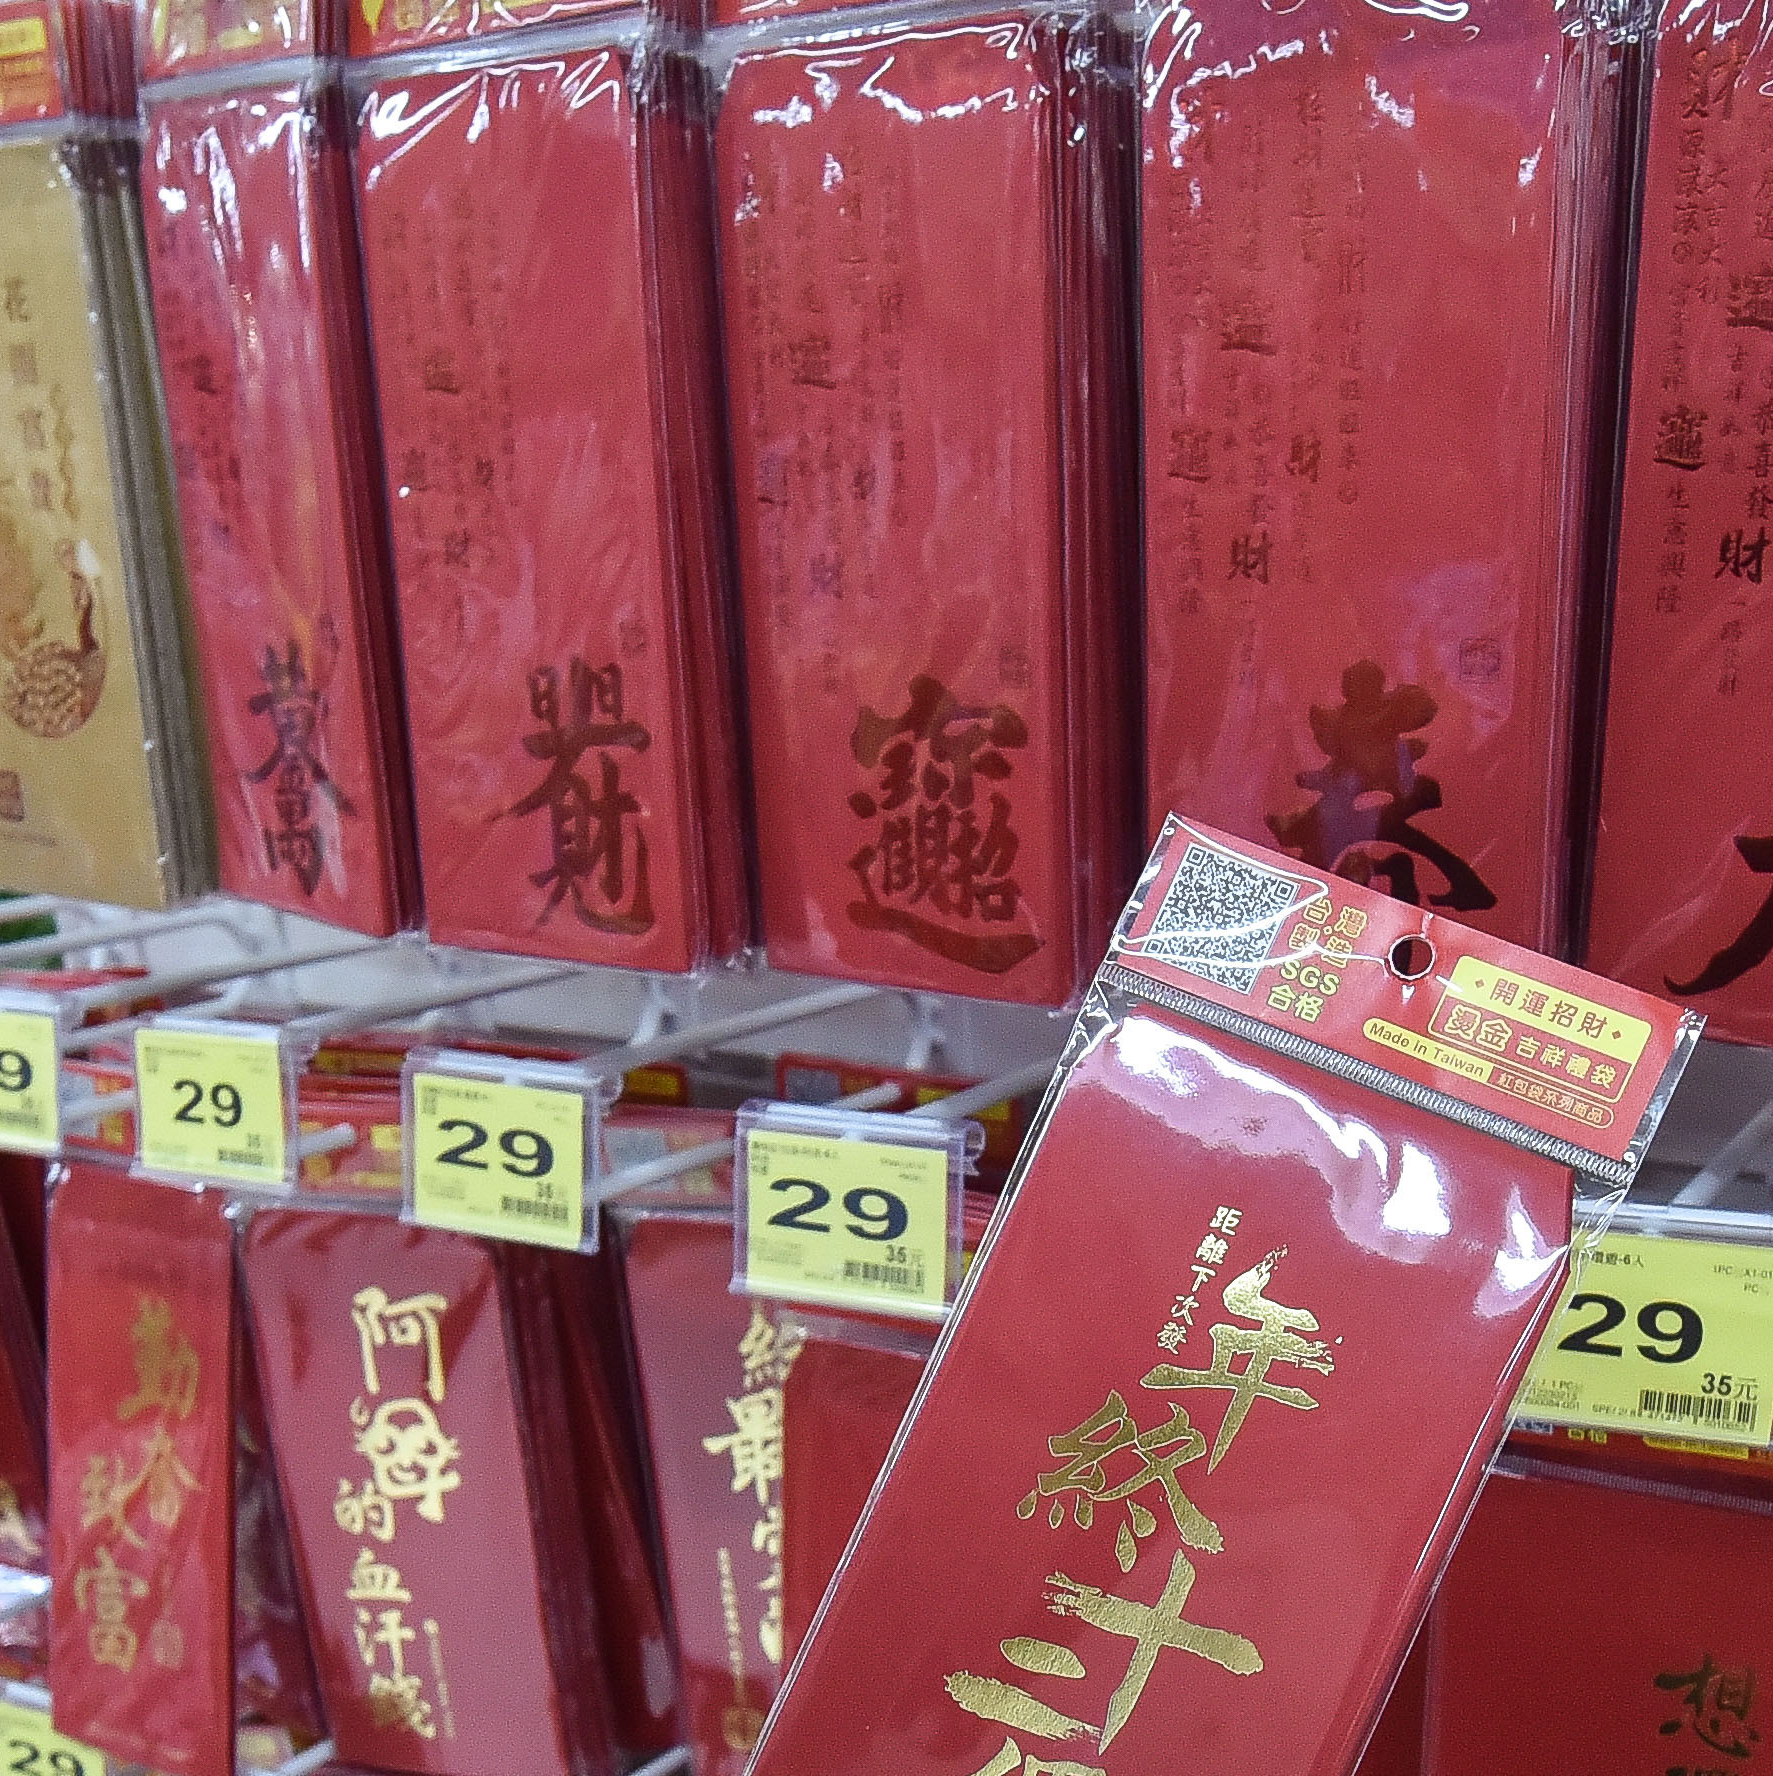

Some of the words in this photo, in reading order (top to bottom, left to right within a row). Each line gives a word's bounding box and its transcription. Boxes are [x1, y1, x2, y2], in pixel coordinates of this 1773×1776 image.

[1264, 660, 1498, 912] 春
[1267, 983, 1325, 1024] 合格
[1280, 959, 1342, 997] SGS
[1489, 977, 1609, 1041] 開運招財
[1369, 1022, 1410, 1048] Made
[1412, 1039, 1428, 1055] in
[1431, 1044, 1486, 1078] Taiwan
[1443, 1003, 1514, 1052] 燙金
[1515, 1034, 1618, 1089] 吉祥禮袋
[172, 1079, 244, 1129] 29
[1497, 1072, 1606, 1125] 紅包袋系列商品
[435, 1117, 556, 1179] 29
[767, 1177, 910, 1242] 29
[1156, 1205, 1243, 1355] 距離下次發
[1556, 1291, 1704, 1364] 29
[1699, 1371, 1759, 1401] 35元
